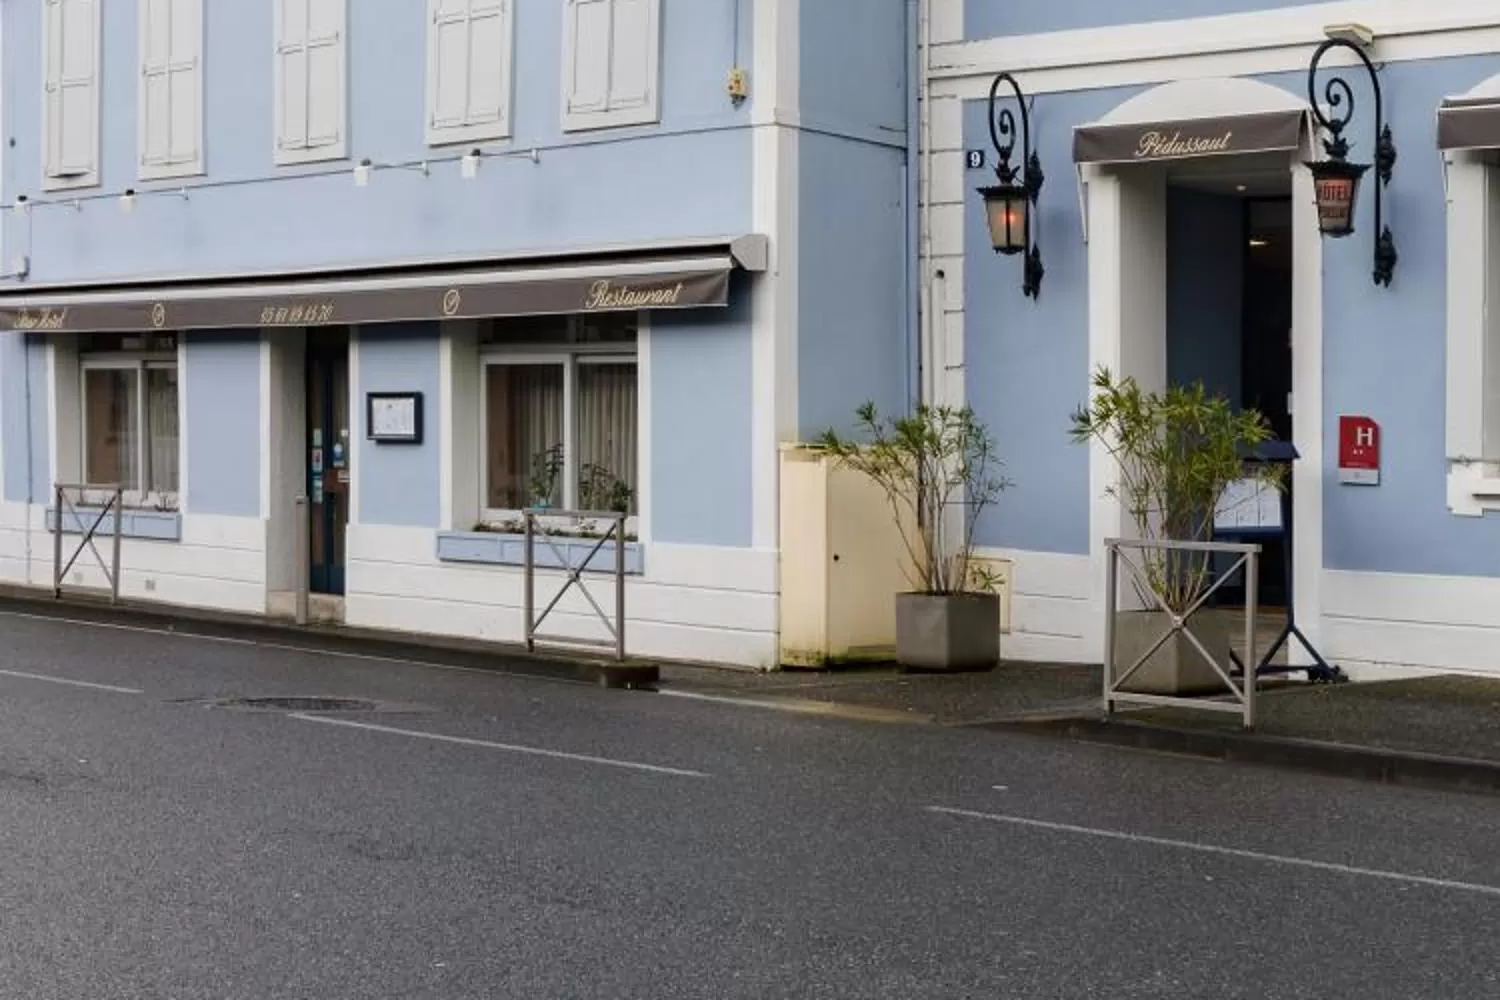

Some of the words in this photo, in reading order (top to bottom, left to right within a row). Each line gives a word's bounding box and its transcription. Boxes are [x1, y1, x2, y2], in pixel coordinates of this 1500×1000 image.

[970, 151, 981, 167] 9
[586, 279, 683, 308] Restaurant
[1356, 426, 1373, 446] H
